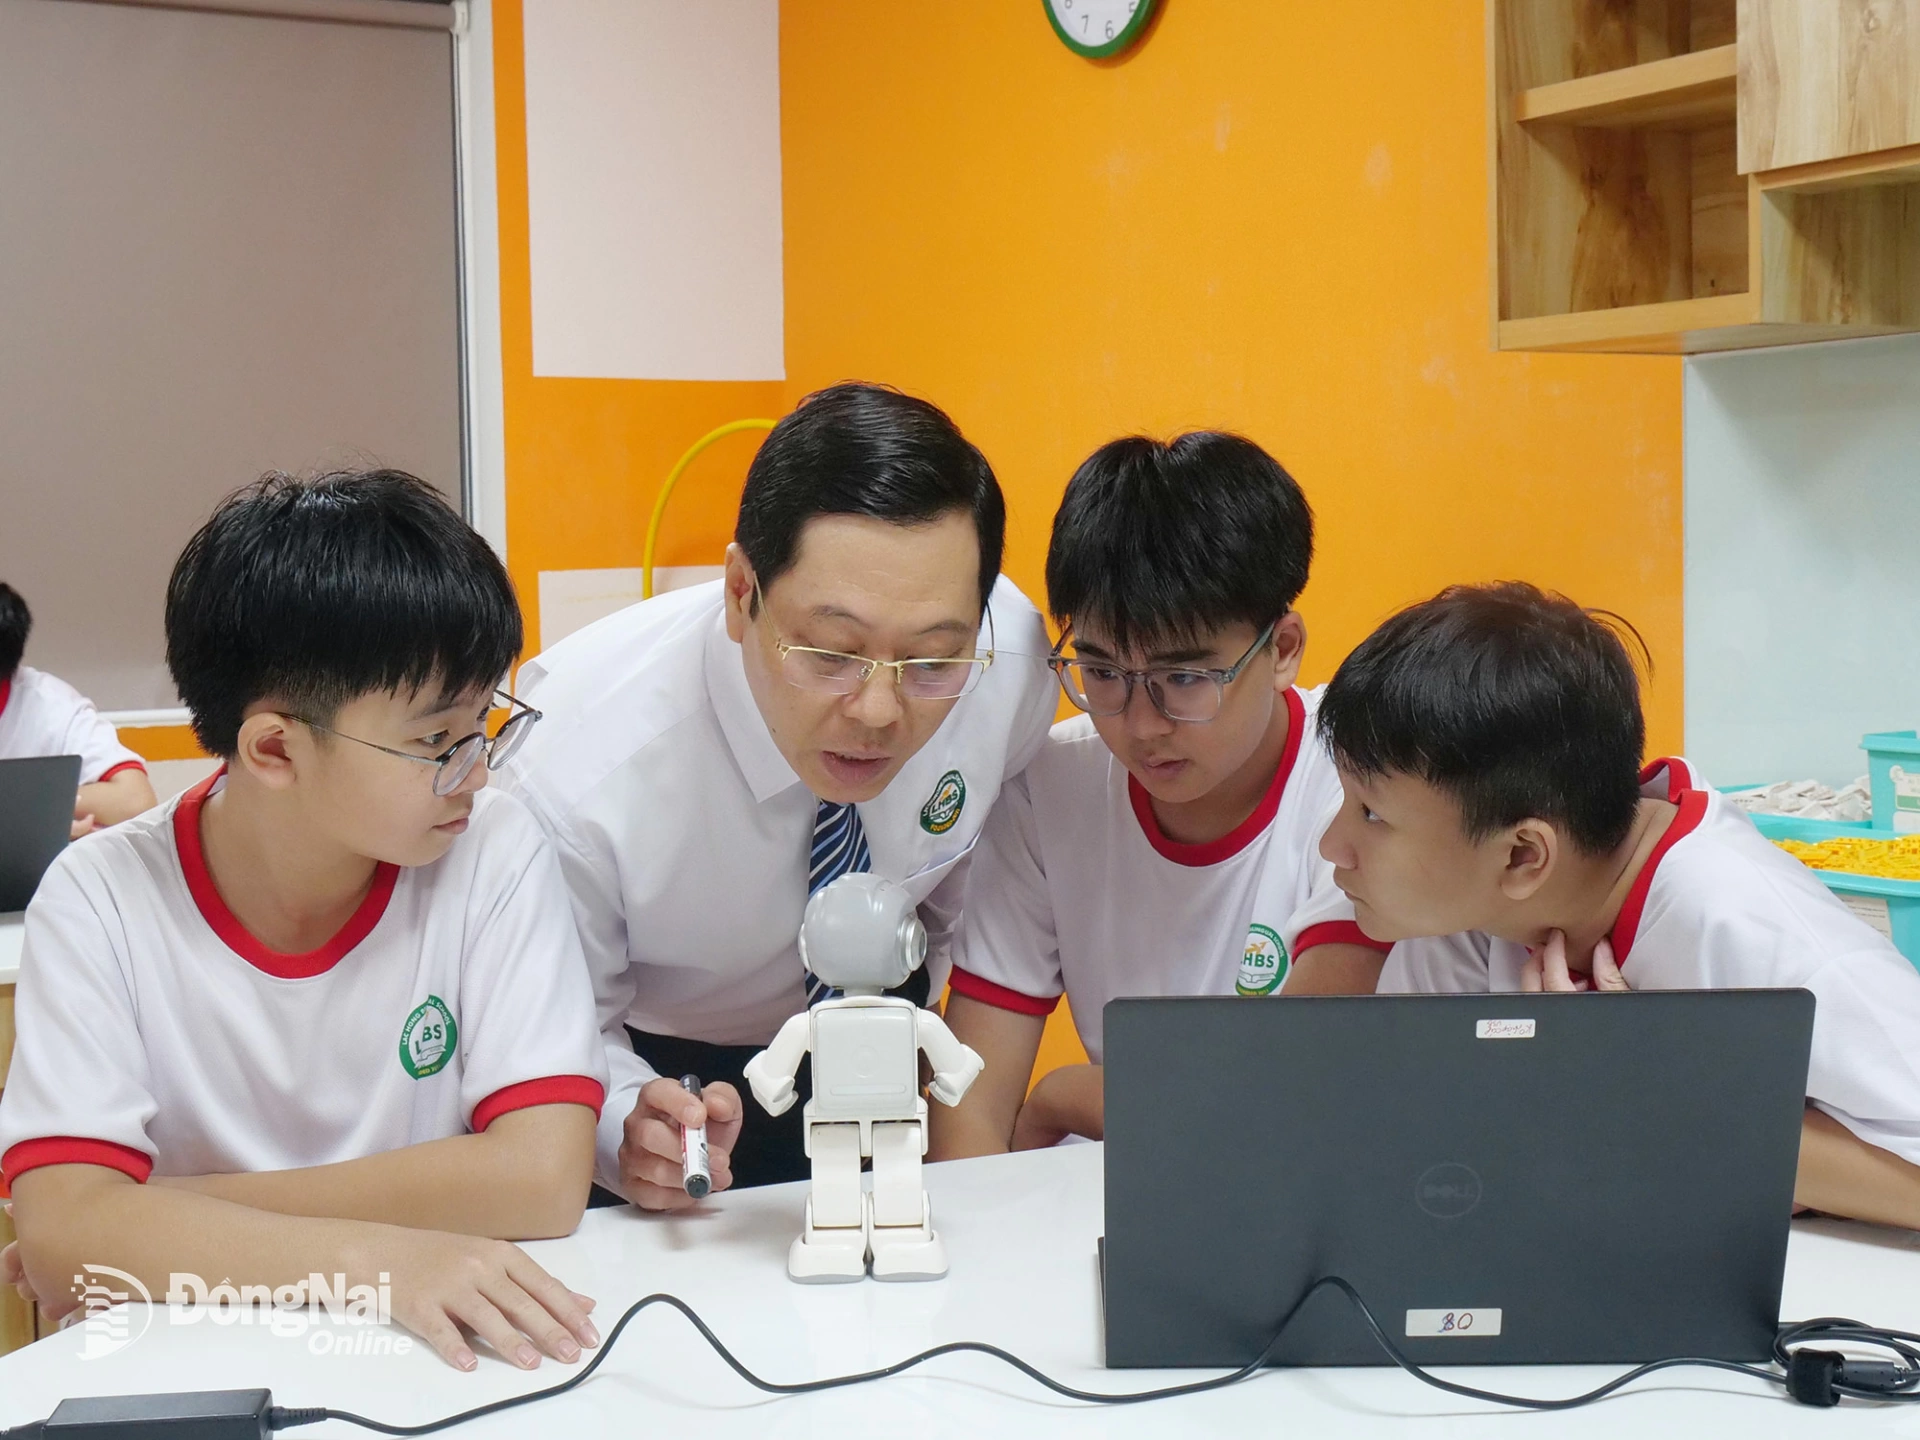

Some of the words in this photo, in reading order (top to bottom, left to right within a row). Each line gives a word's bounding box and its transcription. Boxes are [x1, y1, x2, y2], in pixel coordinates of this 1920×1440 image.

[1081, 14, 1089, 34] 7
[1105, 20, 1114, 40] 6
[1240, 951, 1274, 968] HBS
[1440, 1312, 1473, 1331] 80
